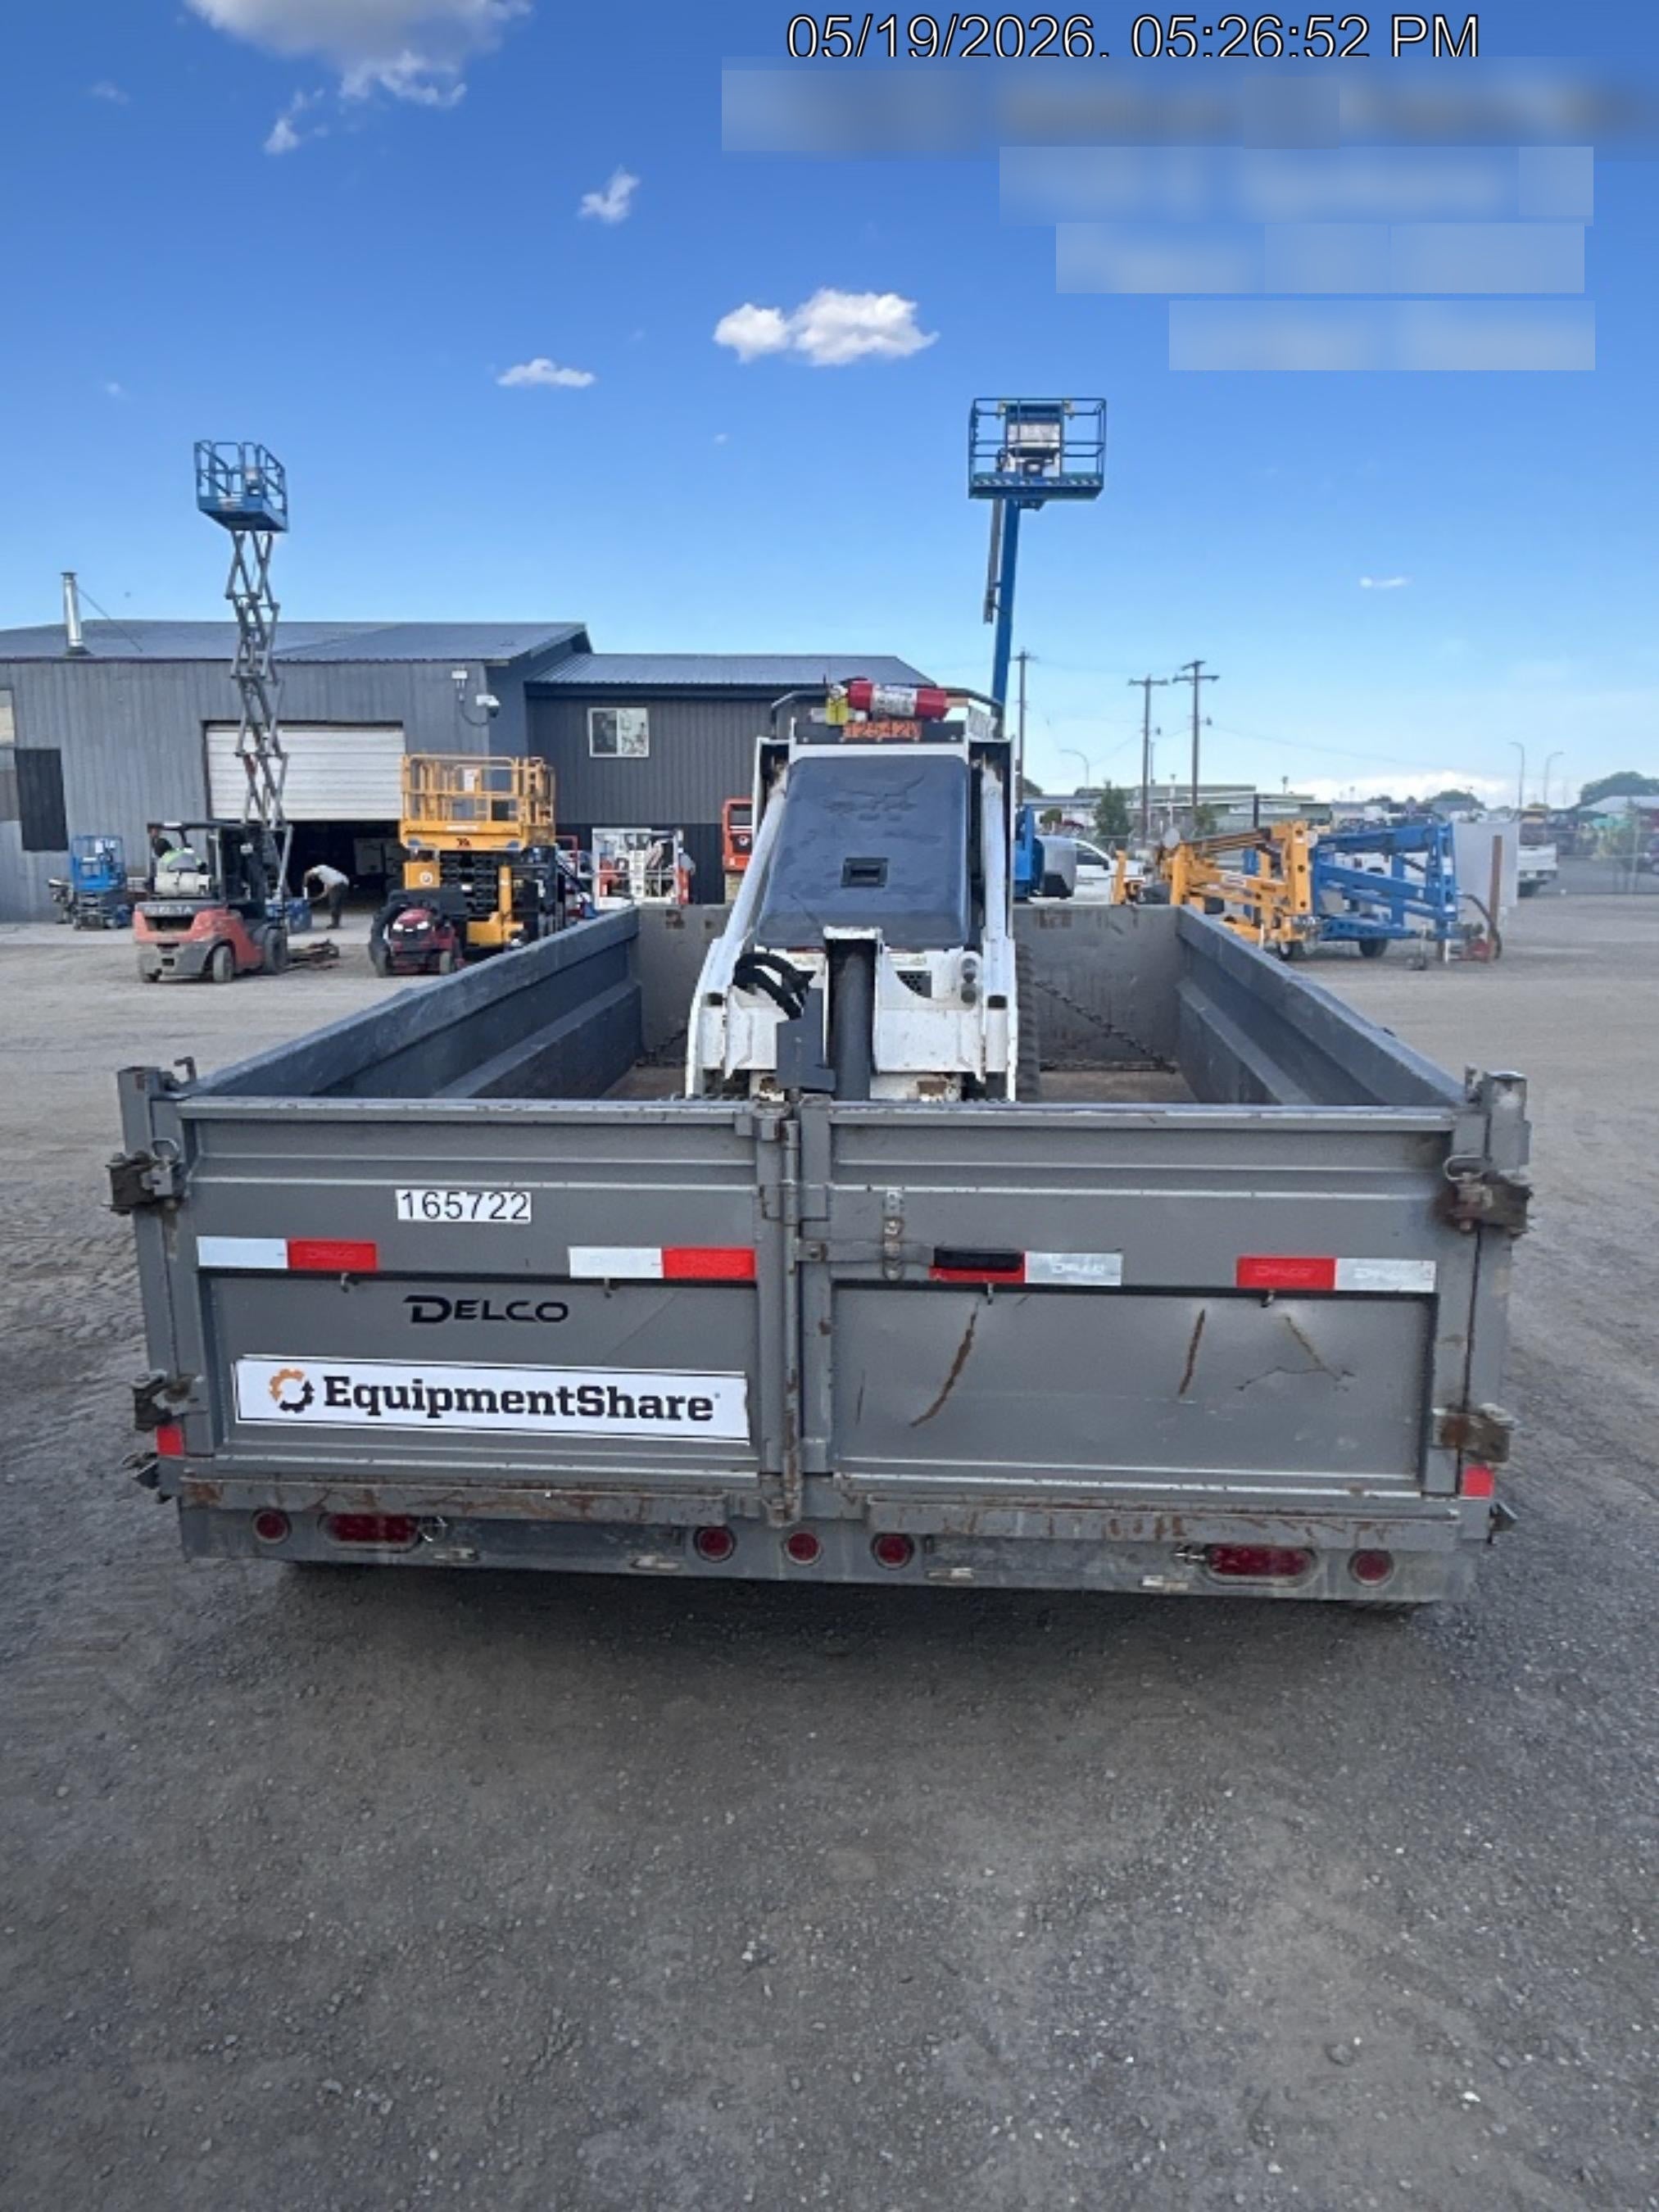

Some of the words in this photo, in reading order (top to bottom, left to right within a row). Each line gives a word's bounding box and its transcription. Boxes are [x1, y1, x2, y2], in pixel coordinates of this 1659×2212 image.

[401, 1190, 529, 1220] 165722
[402, 1294, 569, 1324] DELCO
[324, 1375, 715, 1422] EquipmentShare
